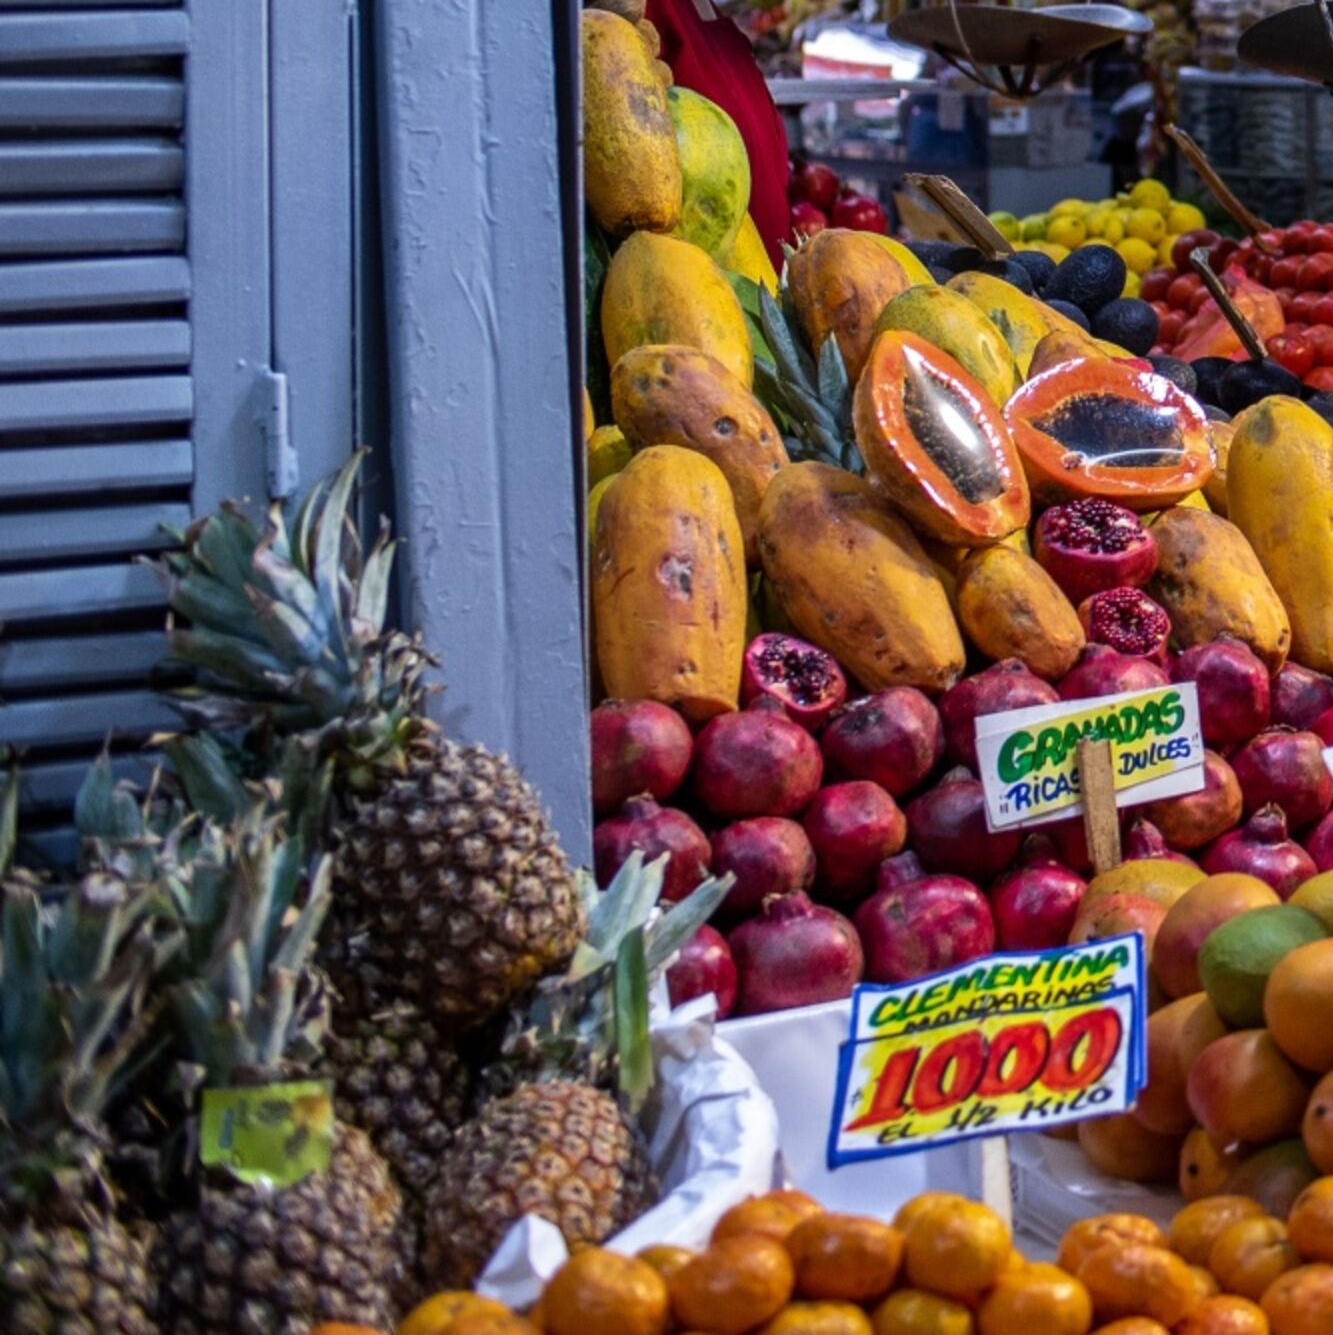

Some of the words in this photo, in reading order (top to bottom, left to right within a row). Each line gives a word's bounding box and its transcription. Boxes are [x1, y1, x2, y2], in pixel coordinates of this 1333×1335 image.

[997, 691, 1186, 784] GRANADAS
[841, 1006, 1123, 1133] 1000
[876, 1122, 919, 1145] EL
